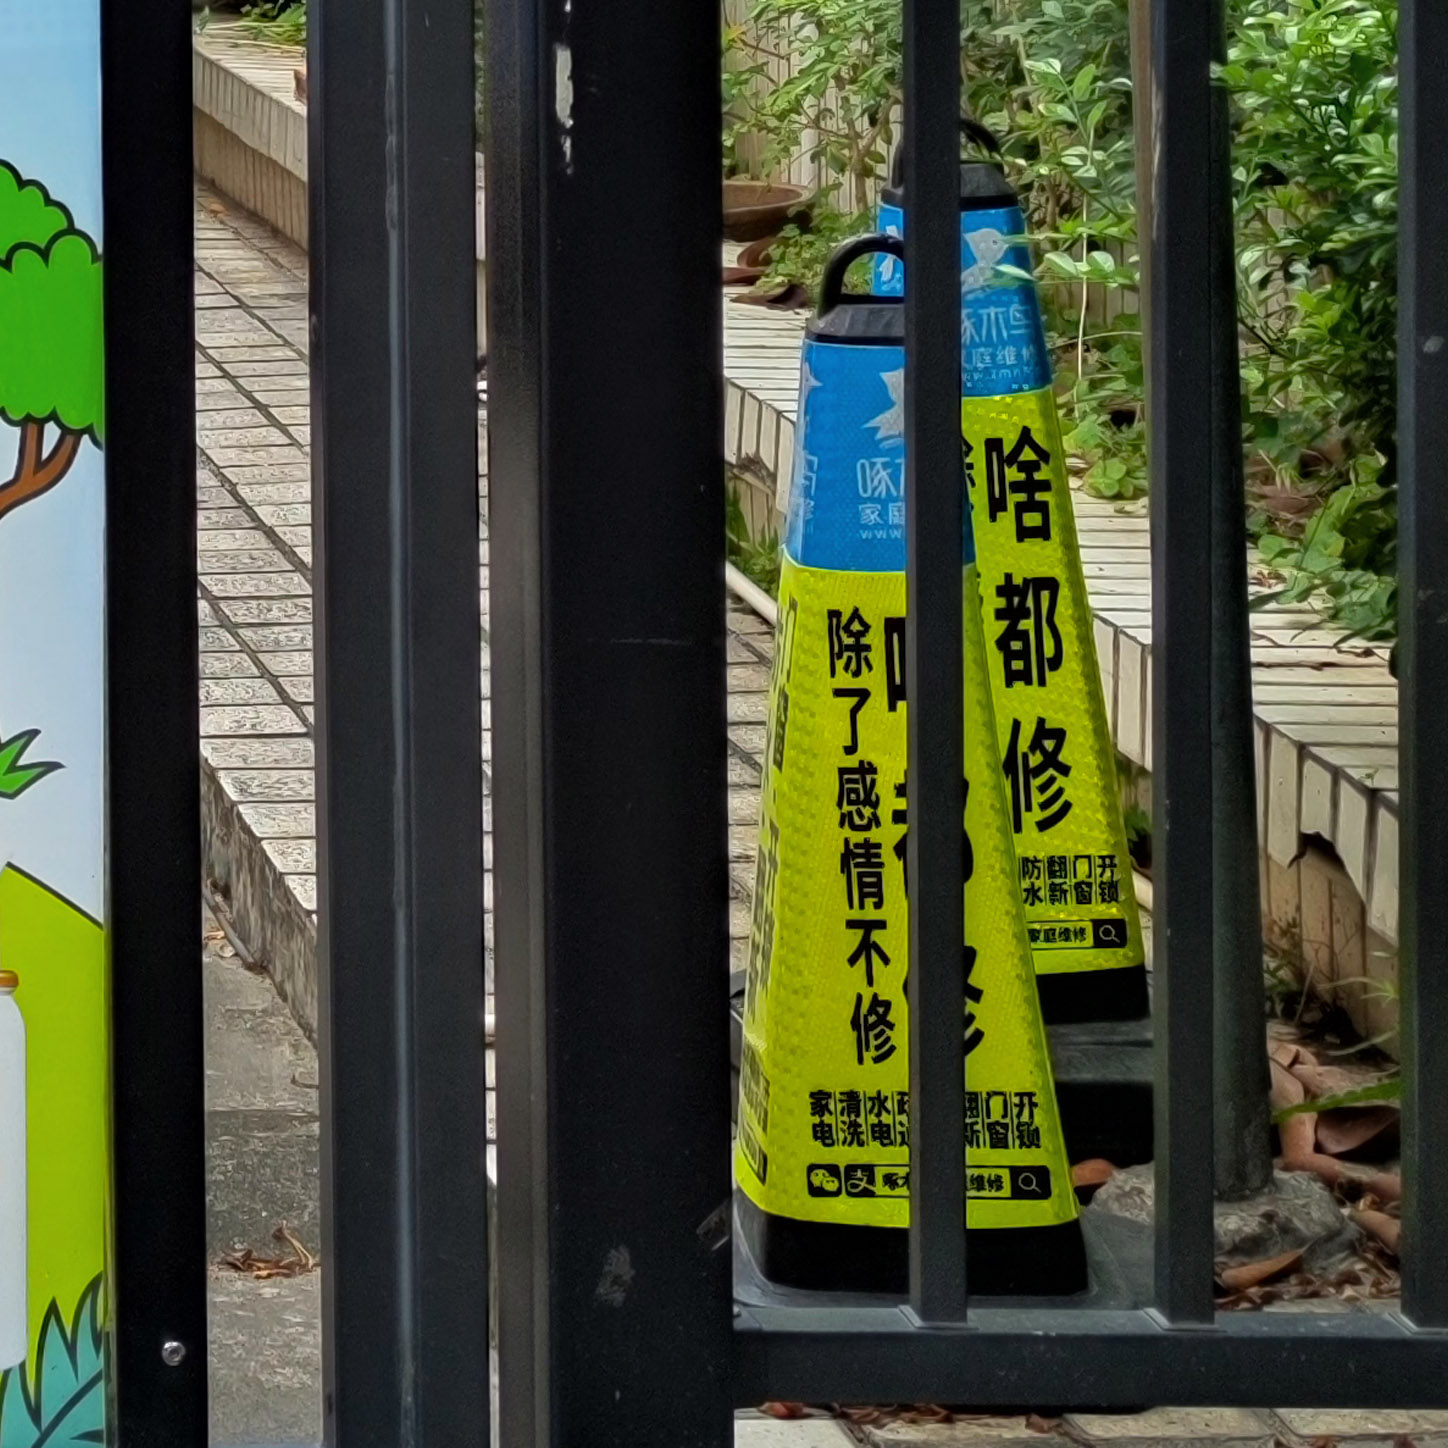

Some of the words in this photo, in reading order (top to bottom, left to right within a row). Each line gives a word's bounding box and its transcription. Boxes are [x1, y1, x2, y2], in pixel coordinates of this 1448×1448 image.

[826, 607, 896, 1065] 除了感情不修
[984, 426, 1073, 834] 啥都修
